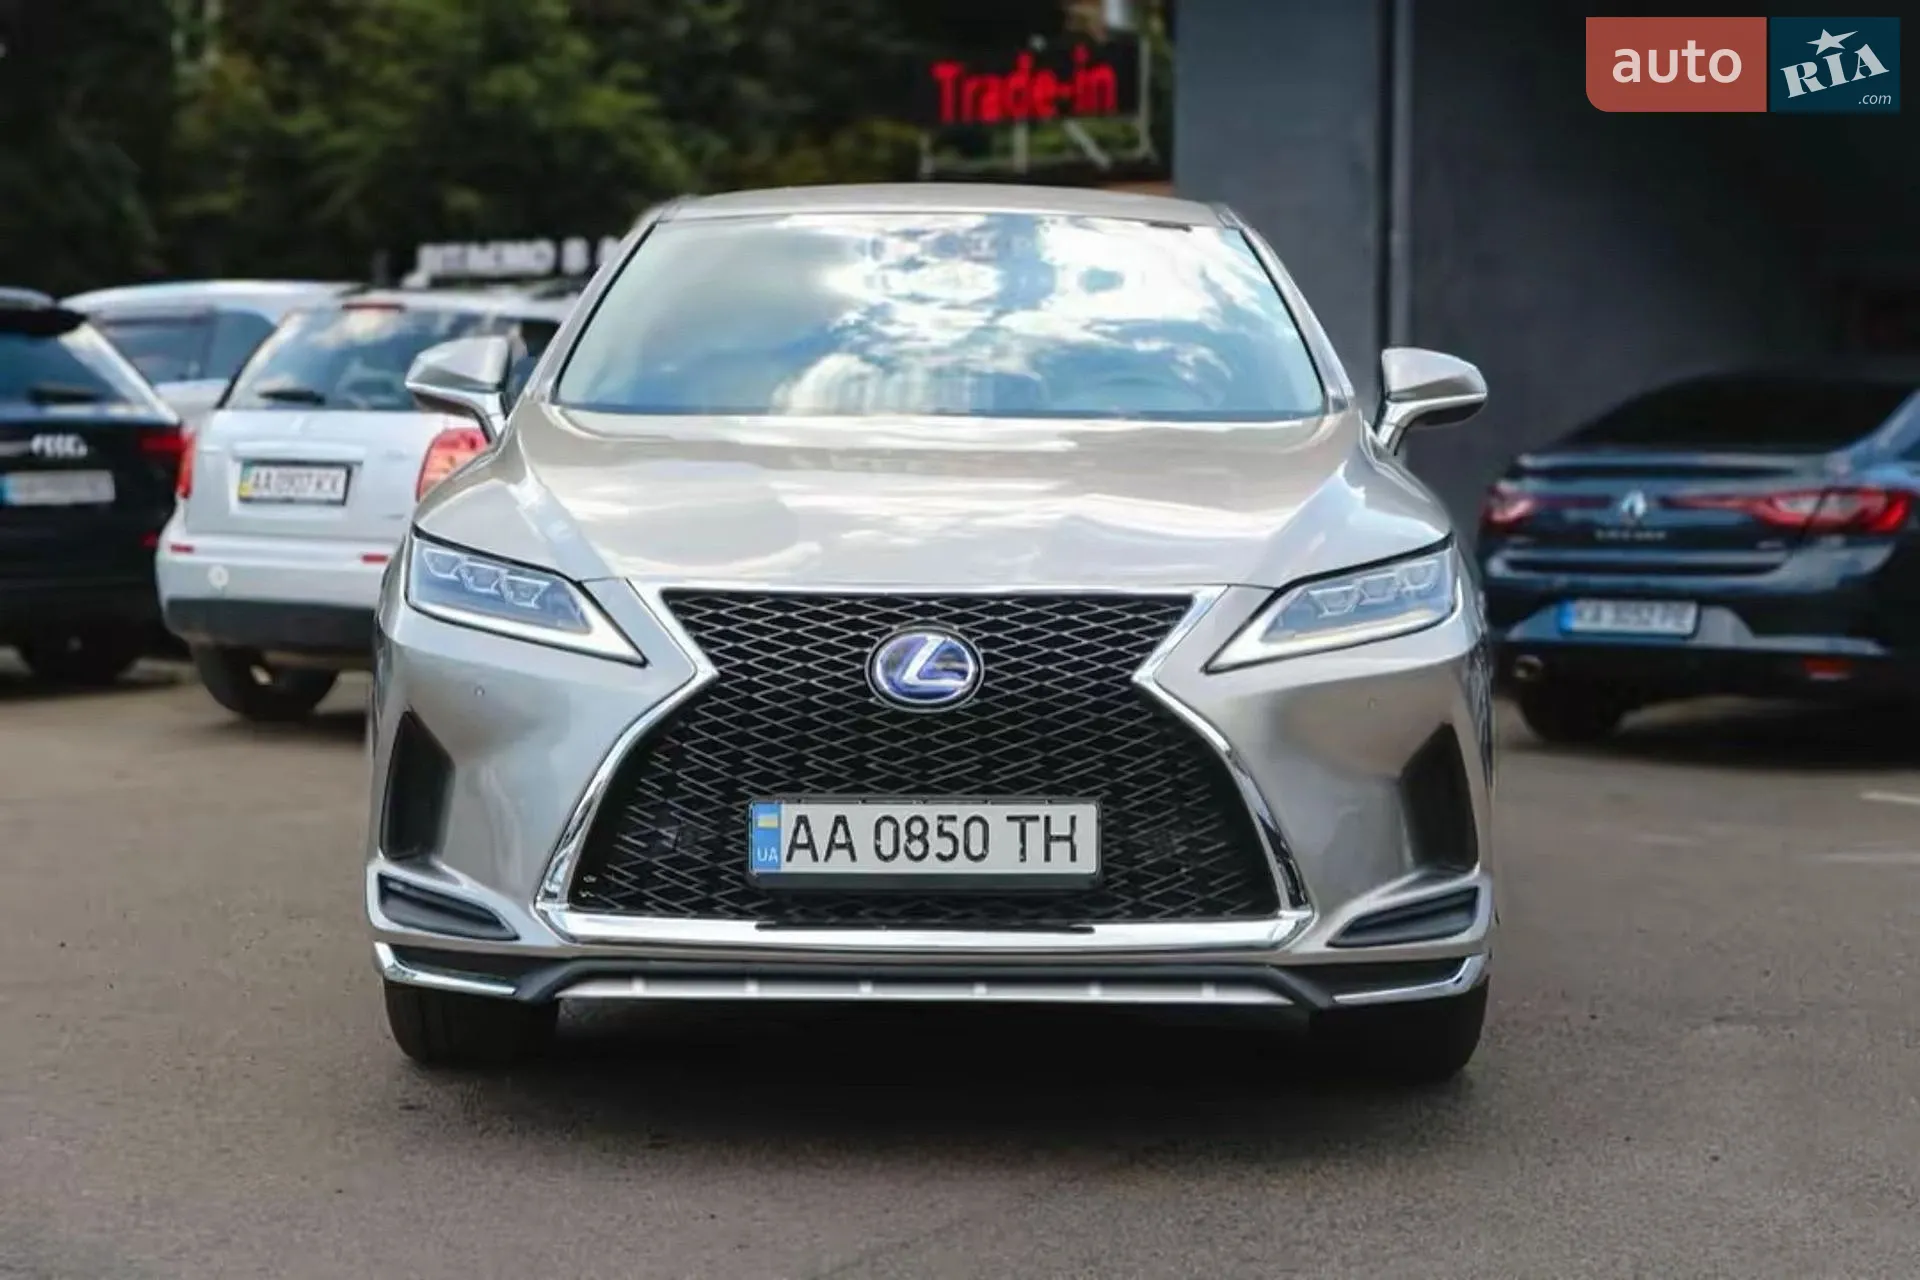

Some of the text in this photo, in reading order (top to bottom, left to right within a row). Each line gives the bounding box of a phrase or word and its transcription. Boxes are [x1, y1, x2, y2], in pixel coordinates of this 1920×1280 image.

[930, 44, 1117, 124] Trade-in
[756, 846, 780, 864] UA
[785, 814, 1078, 863] AA 0850 TH
